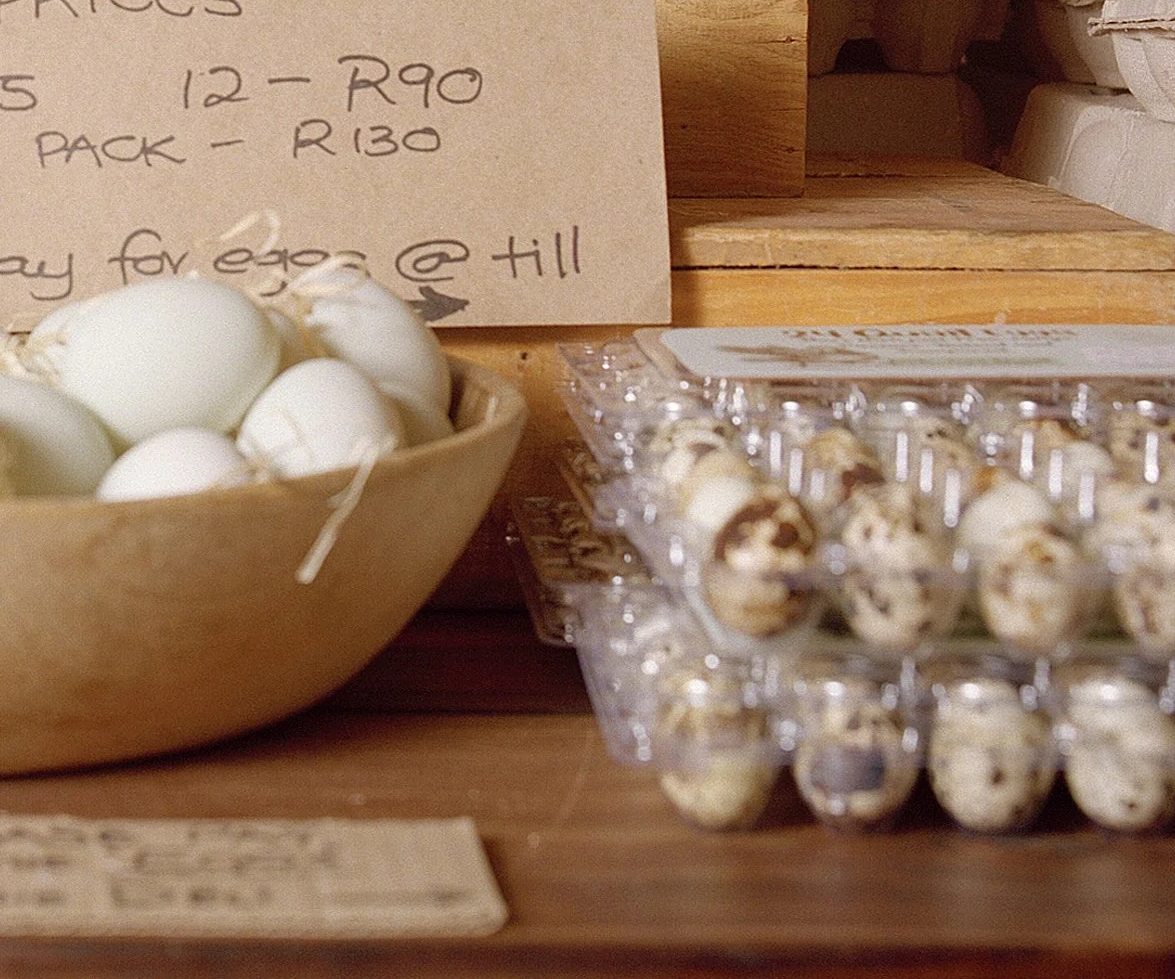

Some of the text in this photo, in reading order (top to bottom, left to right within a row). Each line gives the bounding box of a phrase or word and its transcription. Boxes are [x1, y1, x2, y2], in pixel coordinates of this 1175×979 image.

[183, 65, 248, 110] 12
[337, 54, 483, 112] R90
[35, 130, 186, 168] PACK
[292, 118, 442, 159] R130
[107, 228, 189, 285] for
[394, 238, 471, 283] @
[491, 224, 581, 280] till
